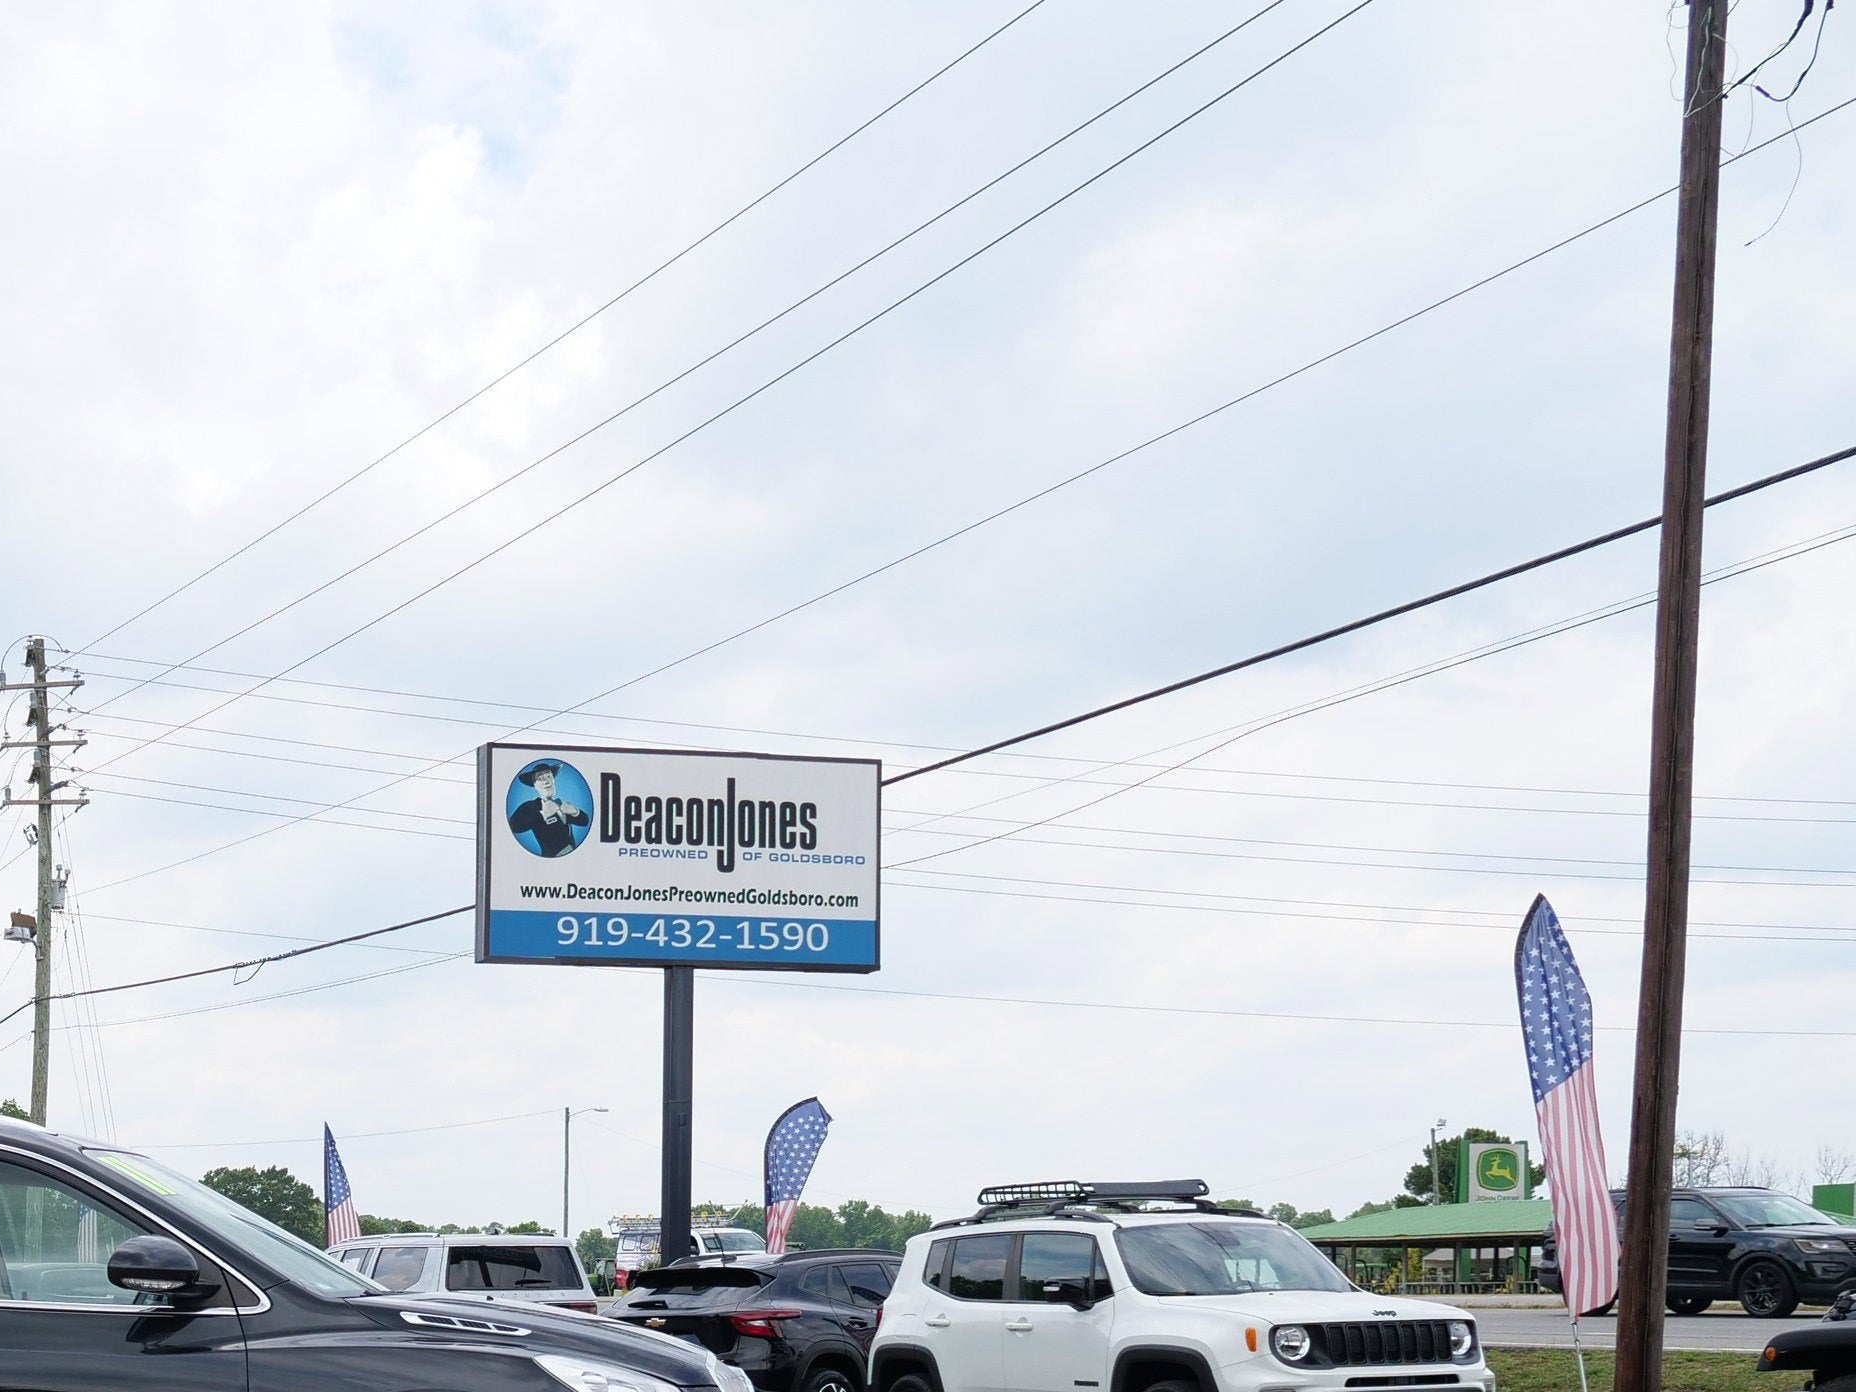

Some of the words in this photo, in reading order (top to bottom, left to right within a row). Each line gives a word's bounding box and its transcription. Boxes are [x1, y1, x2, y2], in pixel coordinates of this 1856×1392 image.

[618, 847, 708, 860] PREOWNED
[742, 851, 763, 861] OF
[769, 852, 866, 865] GOLDSBORO
[520, 883, 859, 908] www.DeaconJonesPreownedGoldsboro.com
[556, 916, 829, 952] 919-432-1590
